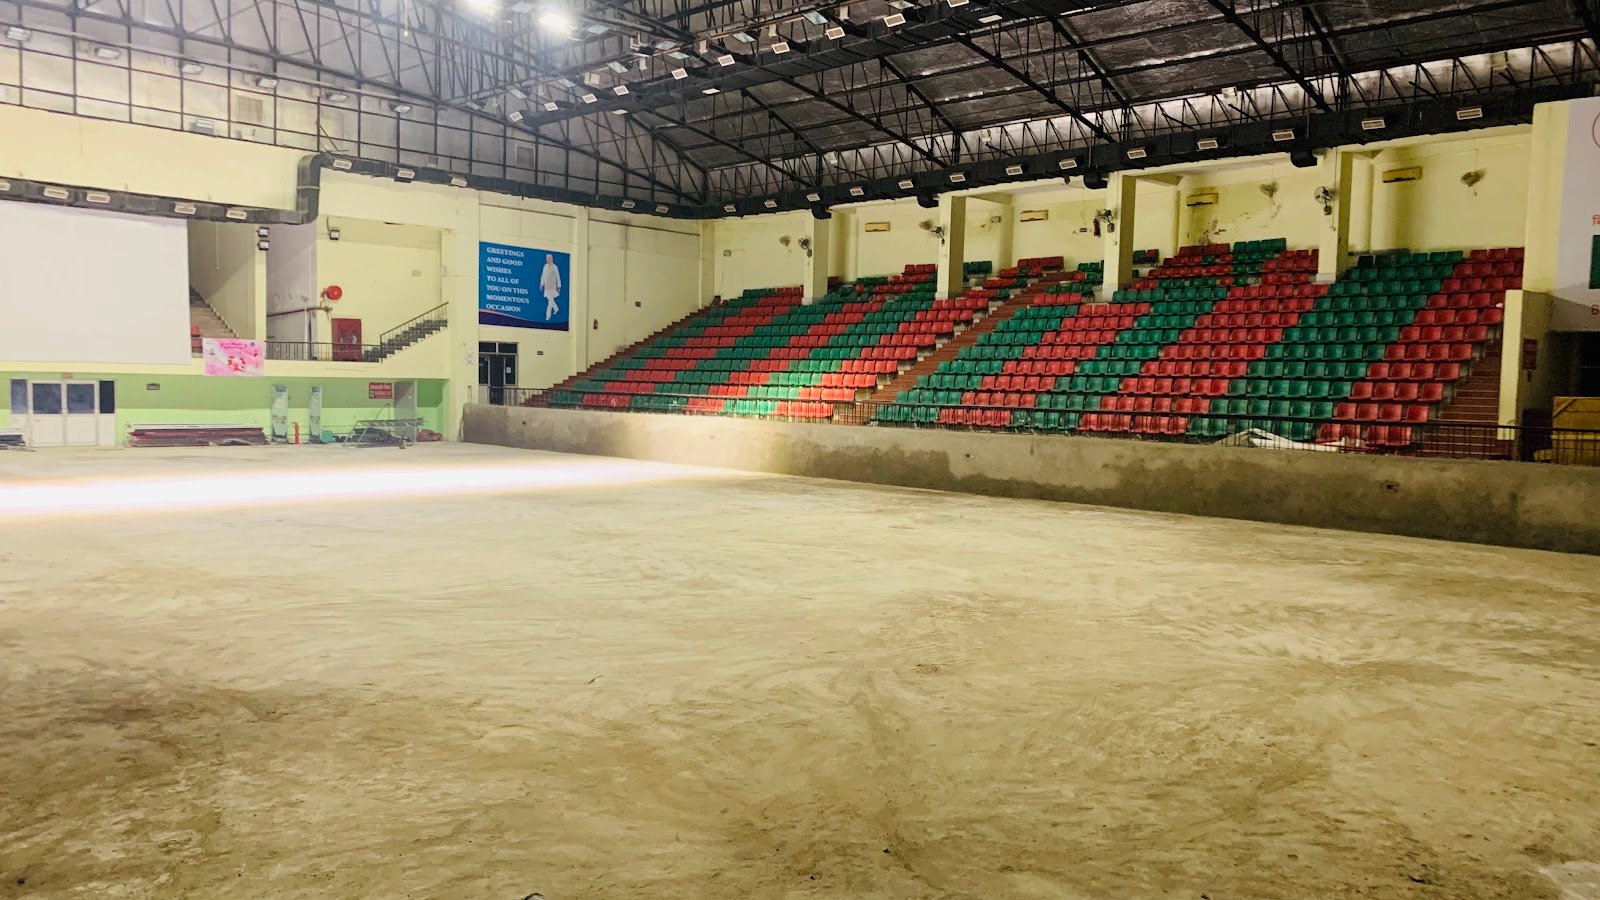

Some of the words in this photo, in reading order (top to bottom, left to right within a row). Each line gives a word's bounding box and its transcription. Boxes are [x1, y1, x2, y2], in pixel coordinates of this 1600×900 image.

[486, 247, 524, 257] GREETINGS
[502, 258, 523, 266] GOOD
[486, 266, 512, 274] WISHES
[513, 287, 528, 295] THIS
[486, 294, 529, 304] MOMENTOUS
[486, 303, 521, 312] OCCASION
